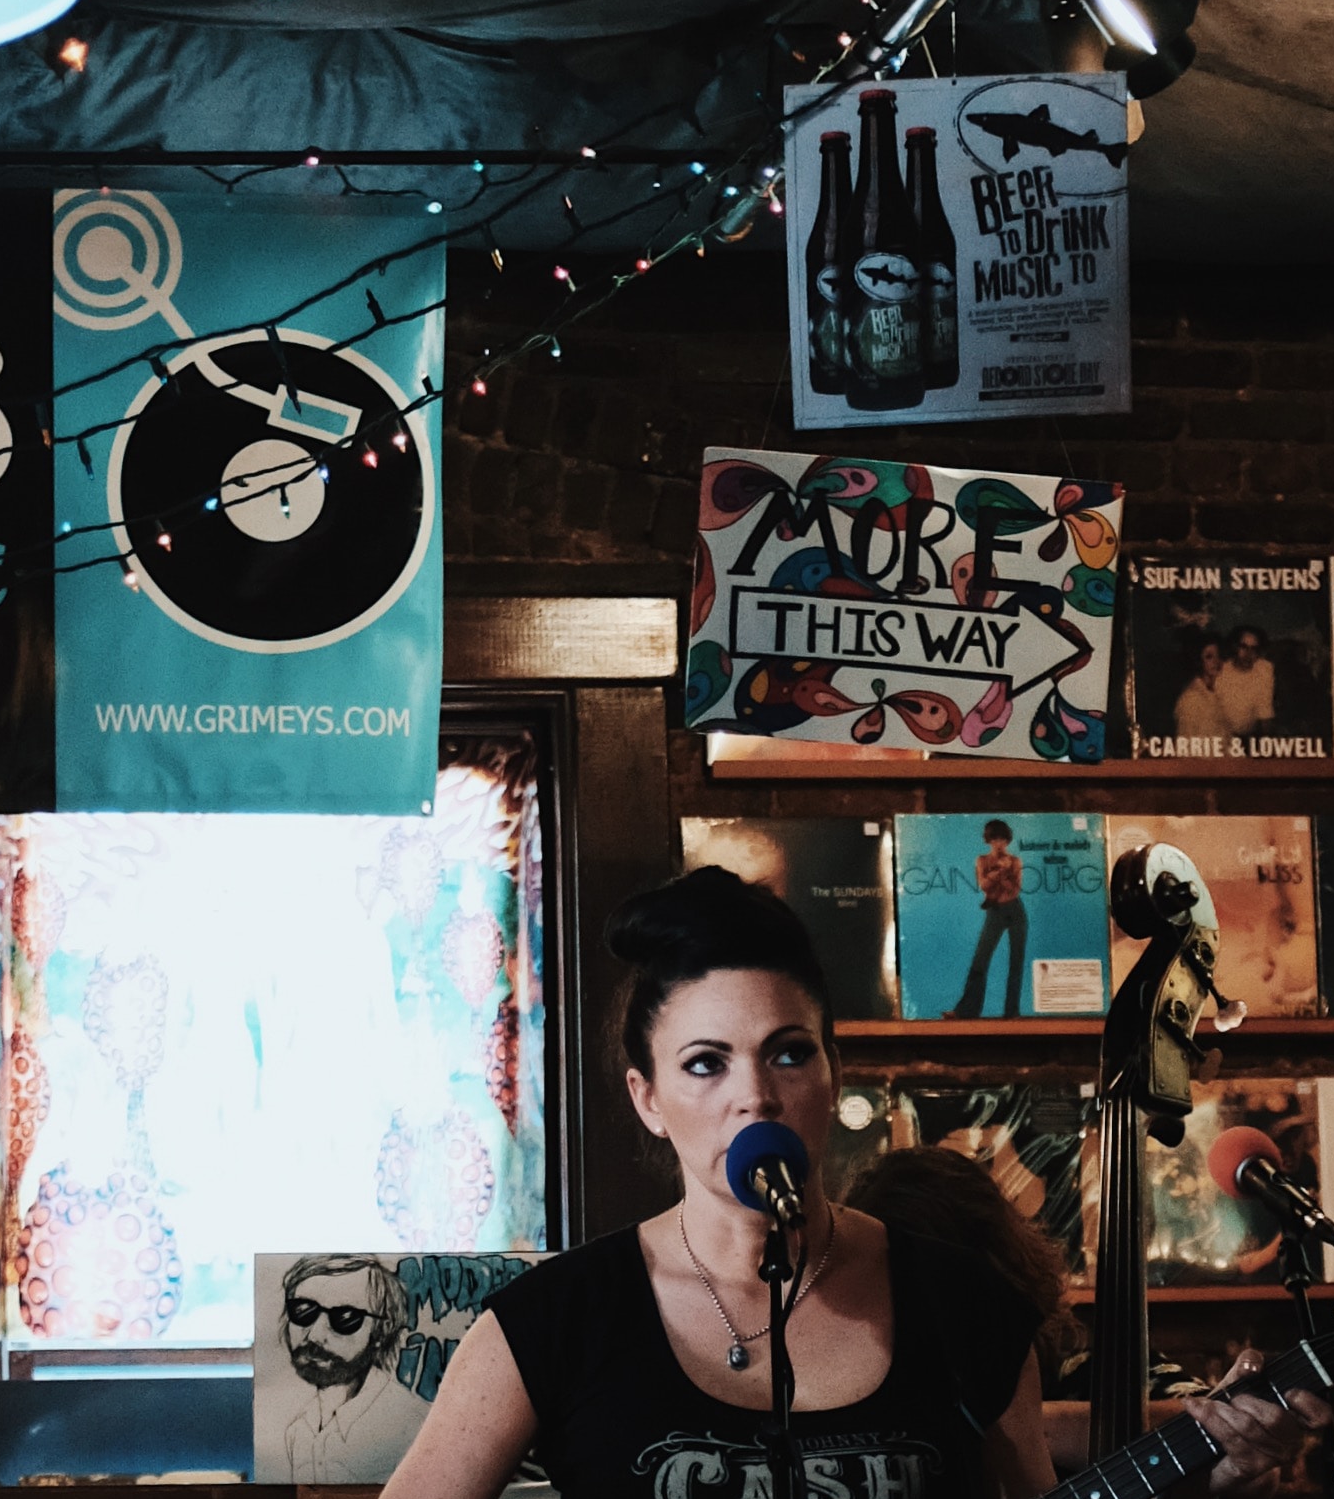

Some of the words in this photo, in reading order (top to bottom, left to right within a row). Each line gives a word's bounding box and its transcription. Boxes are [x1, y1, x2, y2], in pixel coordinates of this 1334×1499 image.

[997, 228, 1021, 256] TO
[1069, 253, 1096, 285] TO
[727, 487, 1042, 594] MORE
[1143, 568, 1221, 591] SUFJAN
[1230, 568, 1322, 591] STEVENS
[757, 601, 906, 658] THIS
[916, 612, 1021, 669] WAY
[95, 702, 412, 738] WWW.GRIMEYS.COM
[1149, 735, 1224, 759] CARRIE
[1229, 736, 1245, 759] &
[1250, 735, 1327, 759] LOWELL
[901, 864, 1103, 896] GAINOURG
